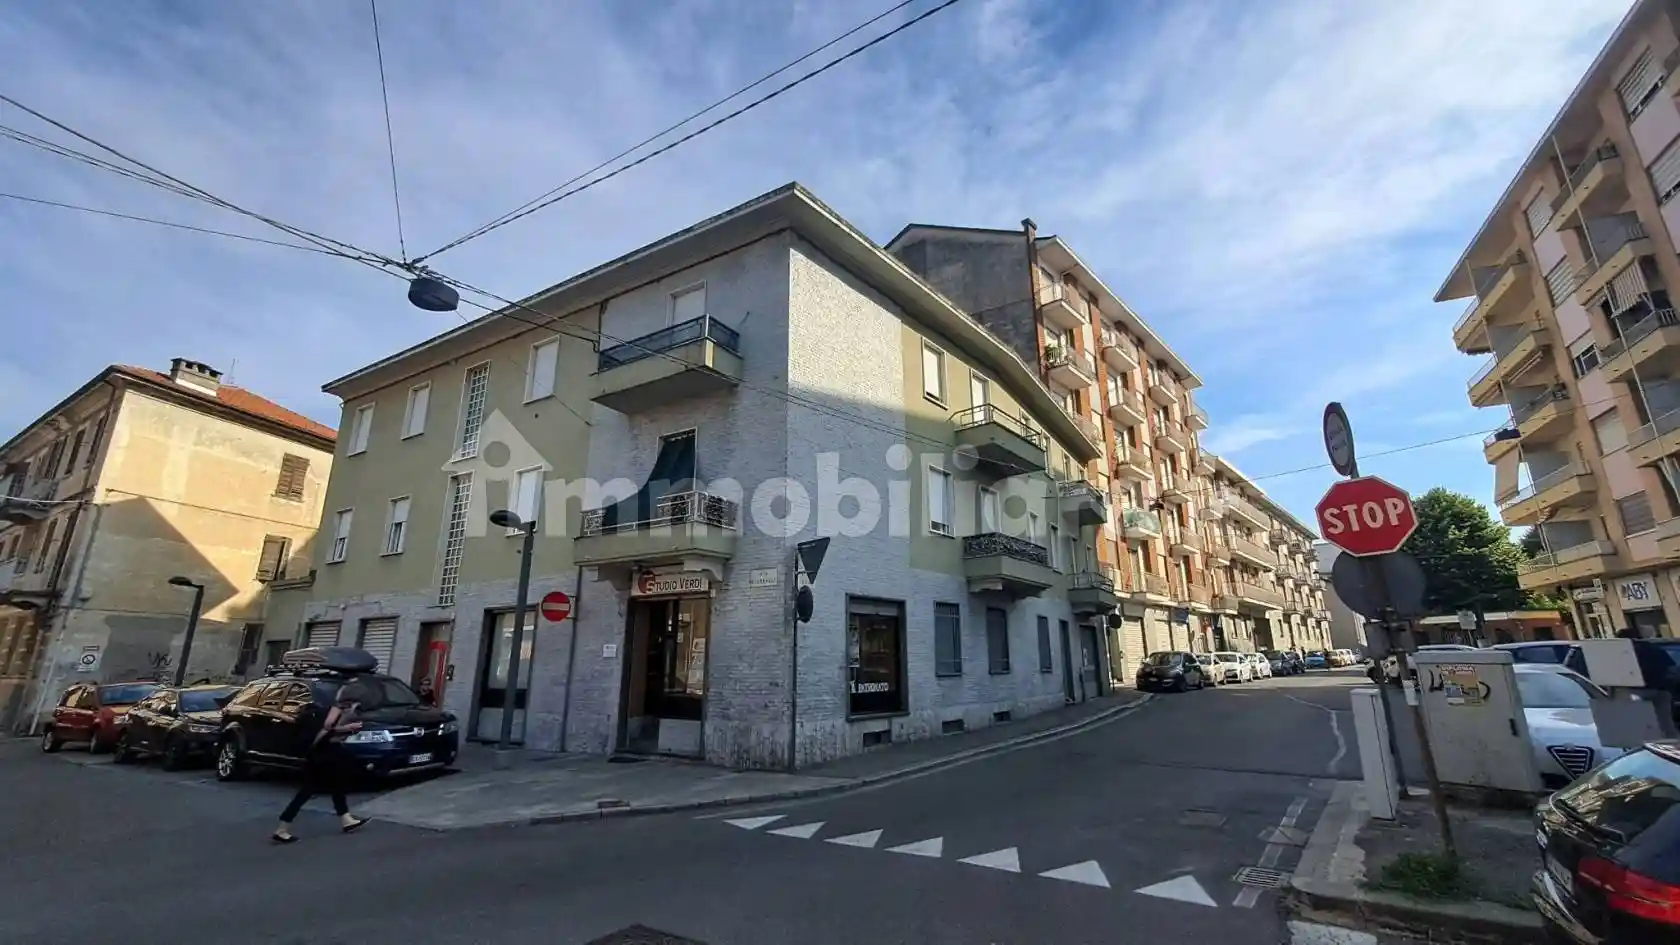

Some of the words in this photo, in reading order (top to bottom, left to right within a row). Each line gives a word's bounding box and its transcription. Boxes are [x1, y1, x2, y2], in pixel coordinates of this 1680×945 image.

[1323, 497, 1405, 534] STOP
[645, 580, 678, 594] STUDIO
[679, 576, 702, 589] VERDI
